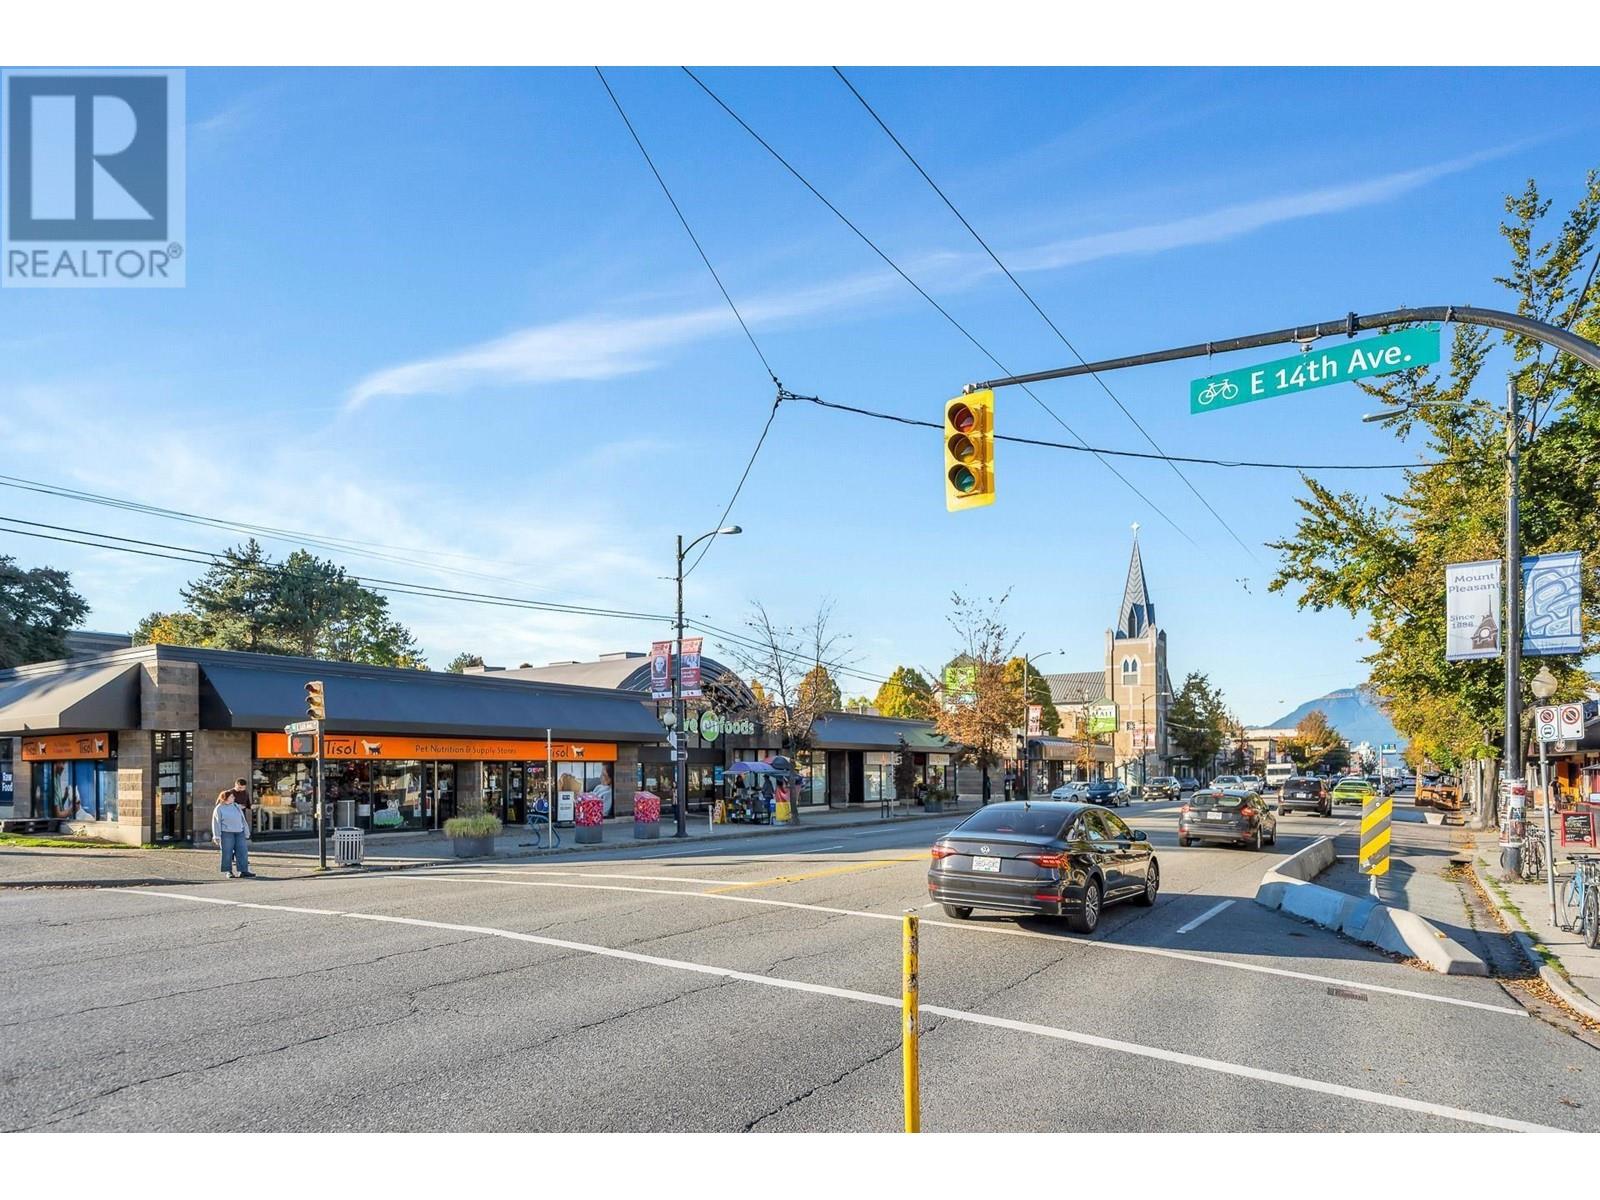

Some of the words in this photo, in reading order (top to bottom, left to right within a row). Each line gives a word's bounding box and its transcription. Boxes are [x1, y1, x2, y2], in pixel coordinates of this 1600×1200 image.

[1251, 371, 1265, 395] E
[1275, 355, 1337, 390] 14th
[1347, 345, 1412, 374] Ave.
[1454, 573, 1495, 583] Mount
[1449, 582, 1501, 593] Pleasant
[720, 716, 754, 734] foods
[324, 739, 357, 755] Tisol
[415, 744, 428, 753] Pet
[430, 744, 465, 754] Nutrition
[465, 745, 472, 753] &
[472, 745, 495, 755] Supply
[497, 746, 517, 754] Stores
[2, 771, 13, 782] Raw
[2, 782, 13, 792] Food
